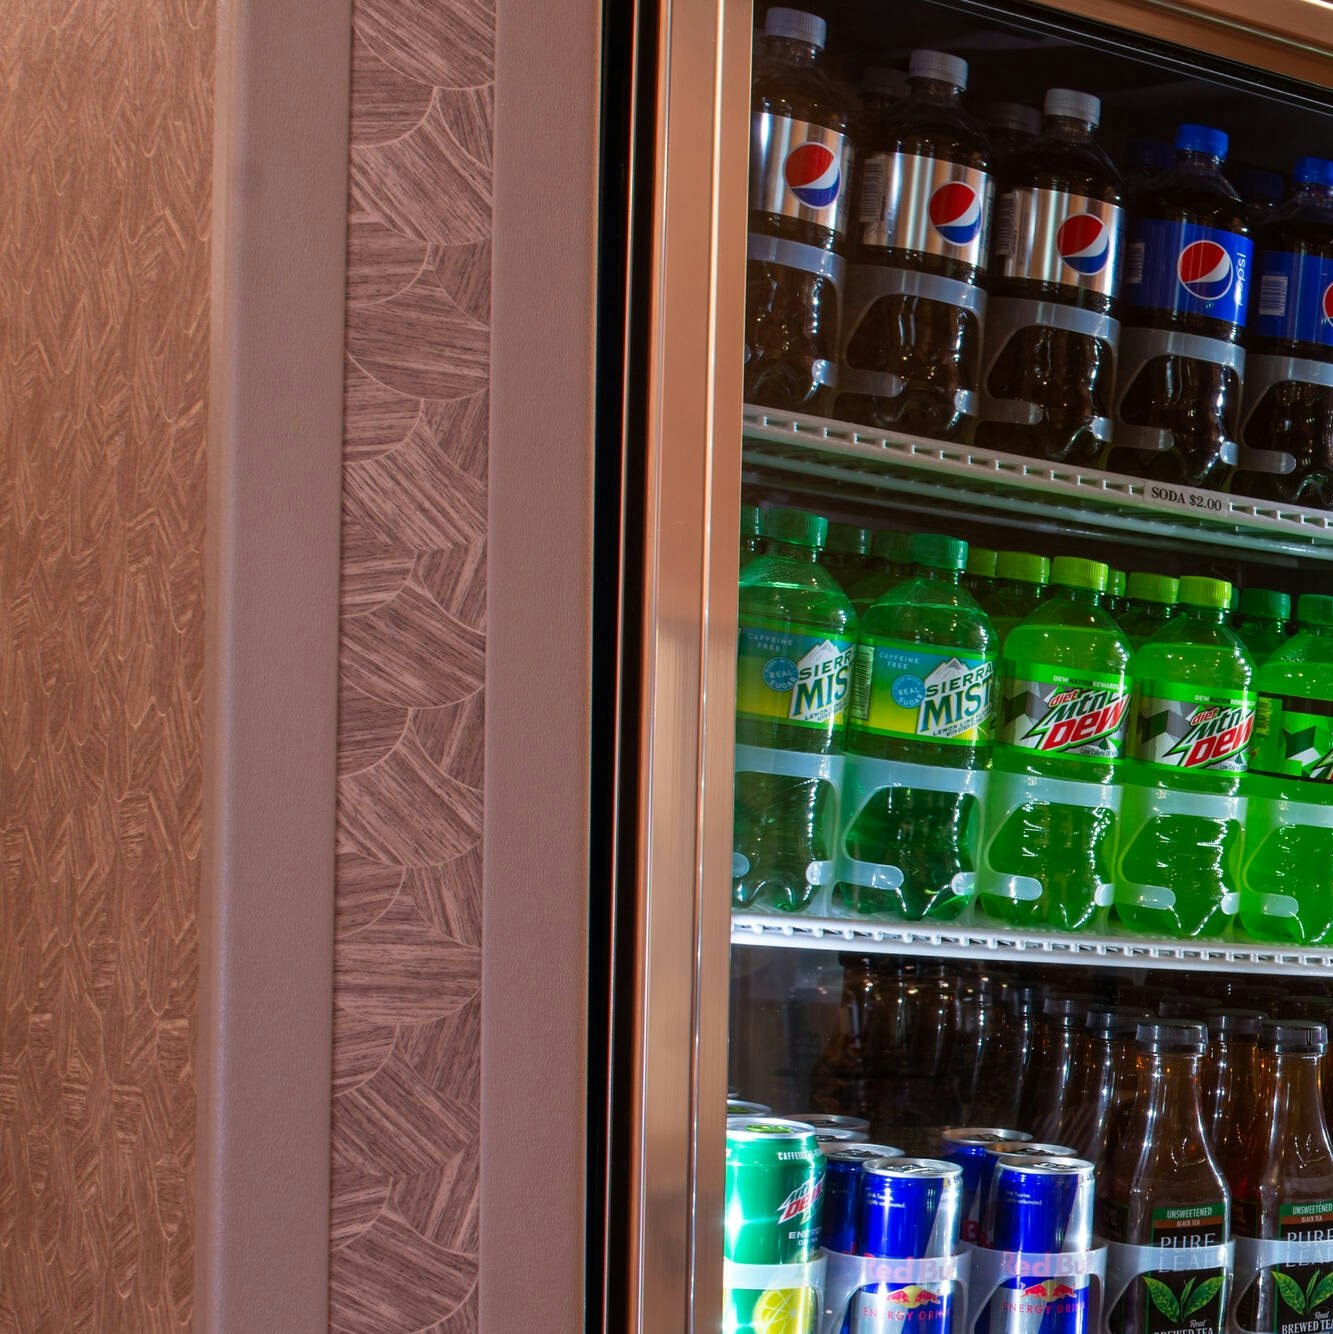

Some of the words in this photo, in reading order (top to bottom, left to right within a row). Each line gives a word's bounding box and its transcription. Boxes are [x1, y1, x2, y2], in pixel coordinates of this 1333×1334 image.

[1152, 486, 1185, 506] SODA
[1189, 494, 1222, 511] $2.00
[748, 633, 792, 646] CAFFEINE
[880, 652, 920, 664] CAFFEINE
[925, 662, 992, 697] SIERRA
[922, 679, 992, 734] MIST
[1167, 1207, 1212, 1218] UNSWEETENED
[1292, 1204, 1332, 1215] UNSWEETENED
[1160, 1233, 1216, 1249] PURE
[1281, 1321, 1319, 1334] BREWED
